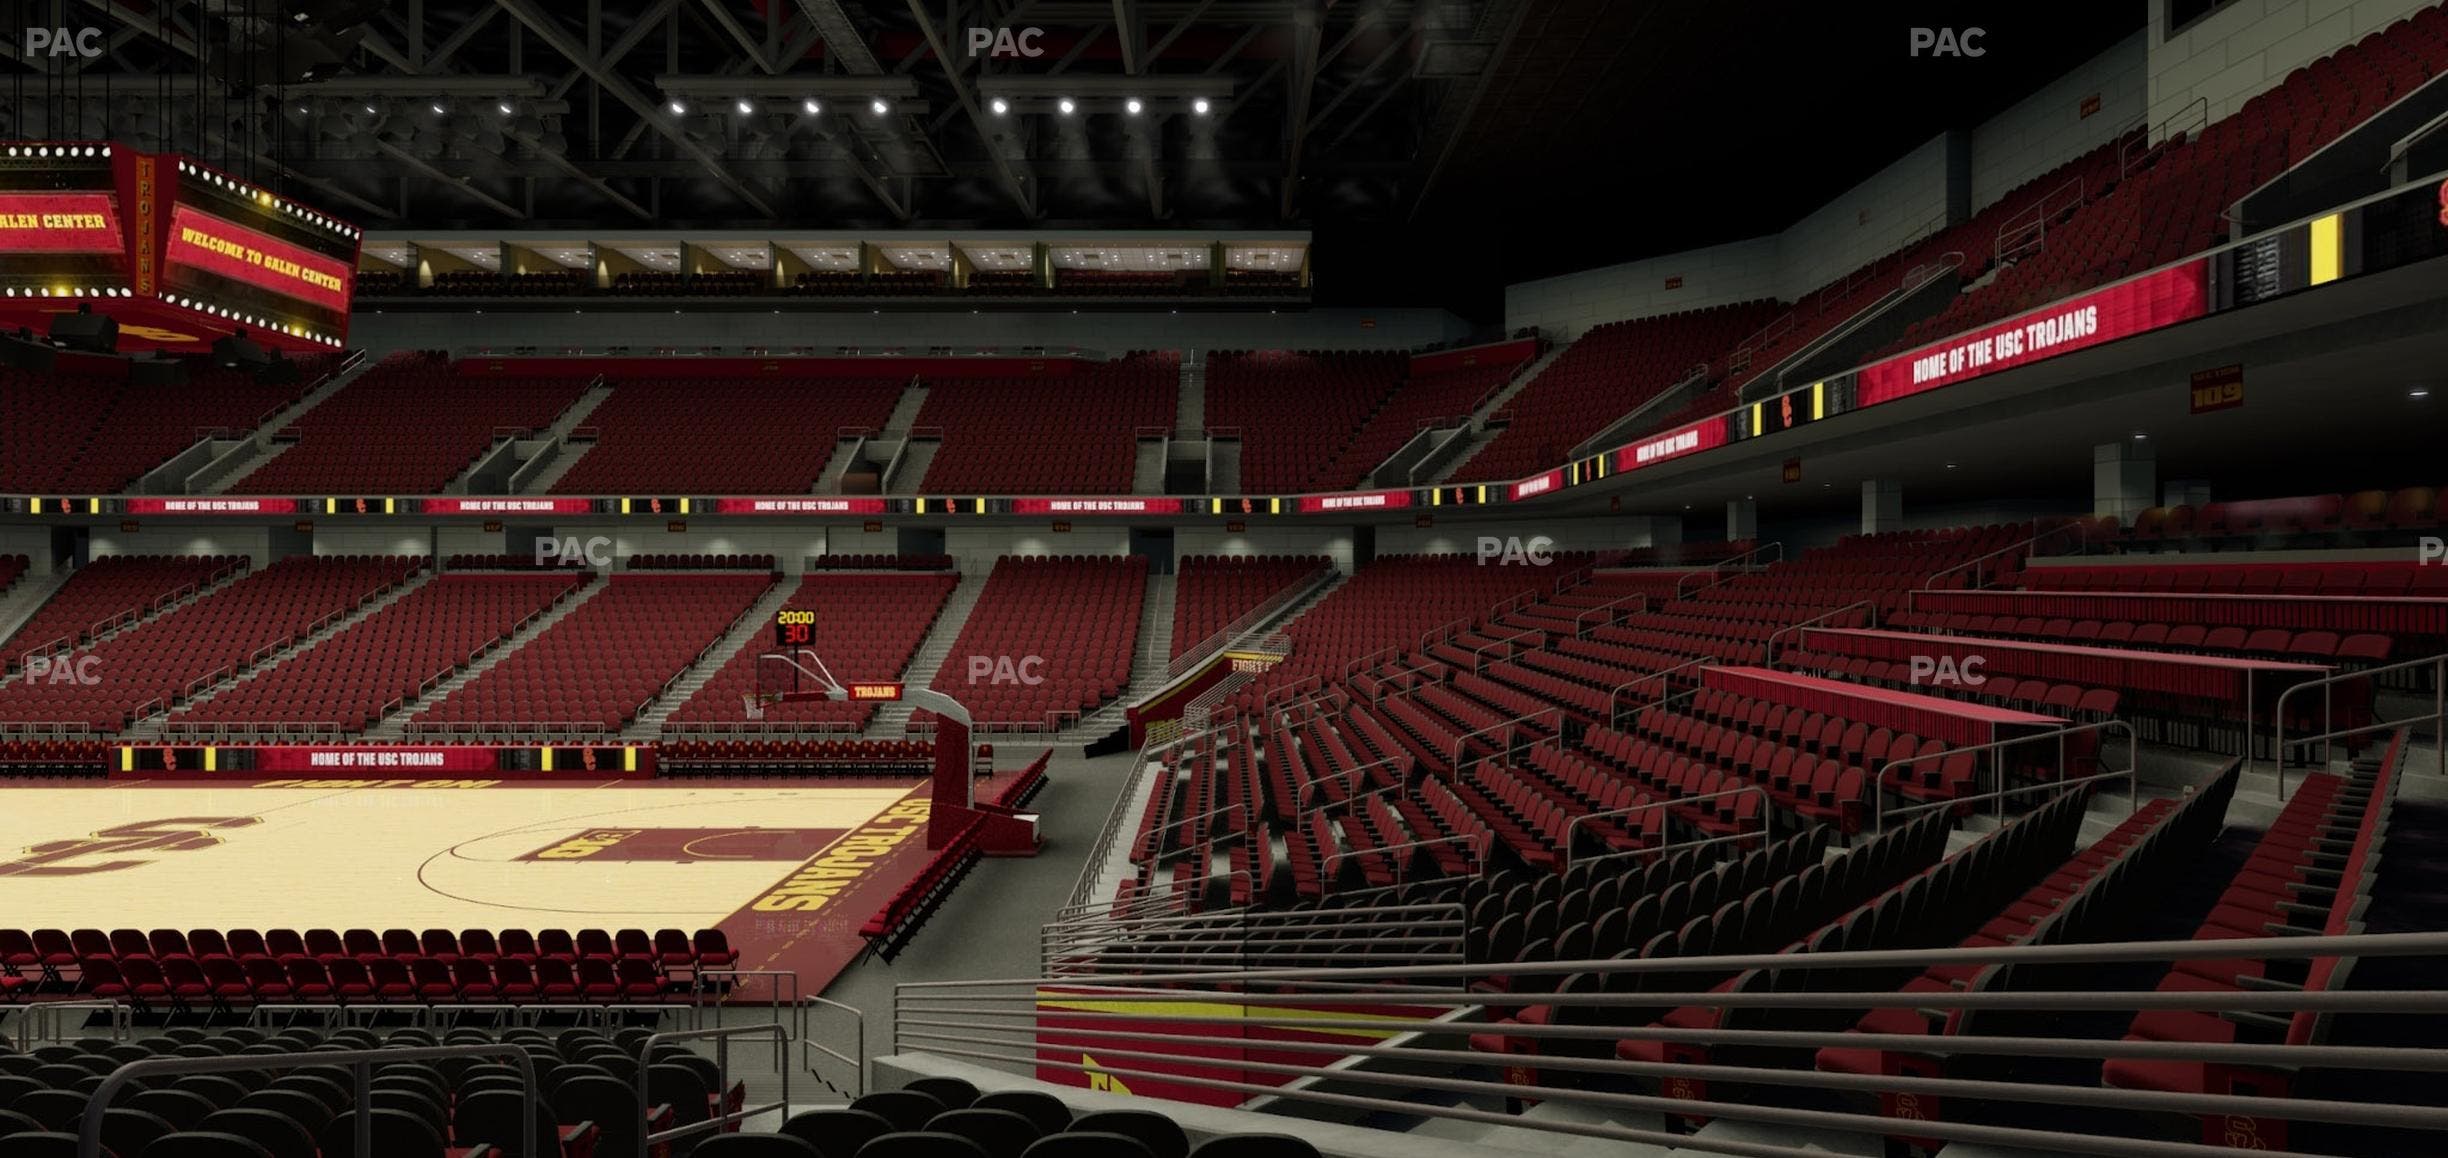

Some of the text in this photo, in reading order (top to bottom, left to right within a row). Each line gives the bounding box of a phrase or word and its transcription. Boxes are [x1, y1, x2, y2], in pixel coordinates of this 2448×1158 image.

[42, 213, 106, 229] CENTER
[139, 162, 152, 294] TROJANS
[181, 227, 342, 292] WELCOME TO GALEN CENTER
[1913, 305, 2097, 384] HOME OF THE USC TROJANS
[2191, 382, 2242, 408] 109
[777, 610, 815, 625] 20:00
[785, 624, 809, 642] 30
[854, 686, 896, 698] TROJANS
[311, 752, 444, 766] HOME OF THE USC TROJANS
[751, 798, 932, 912] USC TROJANS
